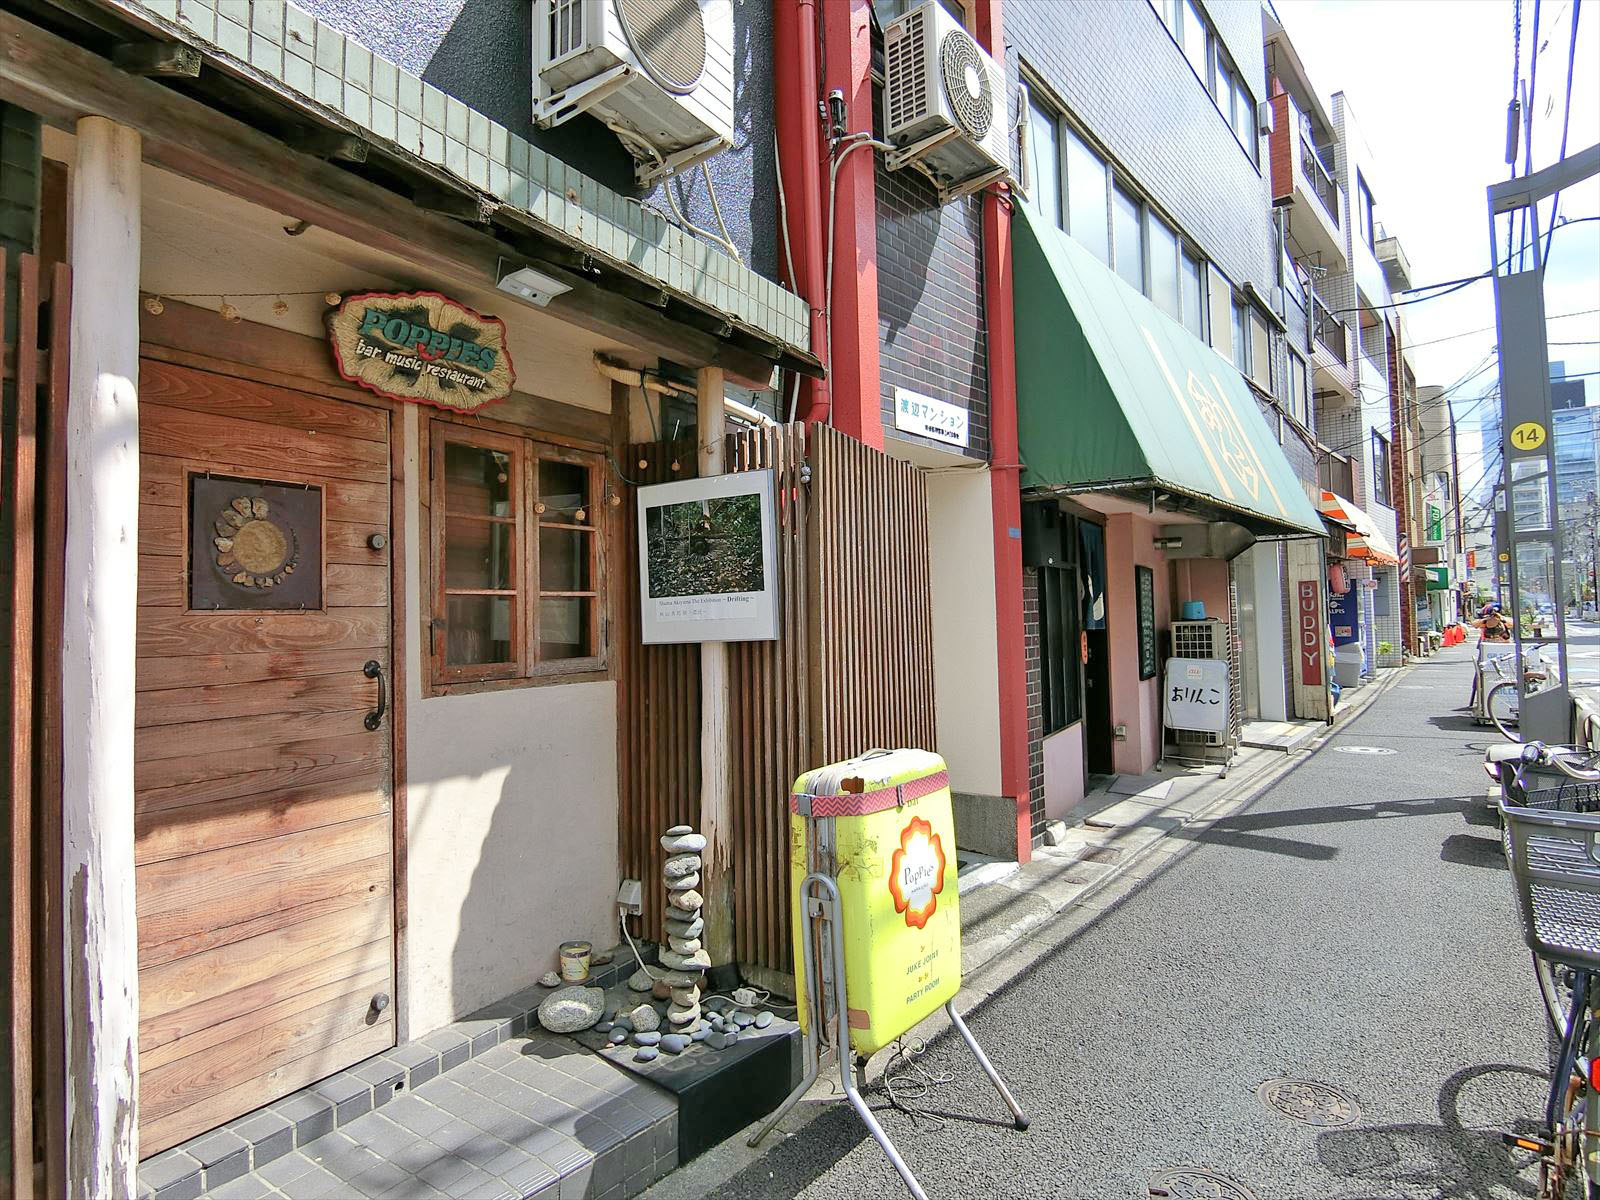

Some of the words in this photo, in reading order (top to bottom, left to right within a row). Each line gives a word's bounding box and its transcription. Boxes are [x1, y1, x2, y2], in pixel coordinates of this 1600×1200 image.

[358, 307, 497, 373] POPPIES
[356, 339, 382, 359] bar
[384, 351, 422, 371] music
[425, 362, 486, 390] restaurant
[1515, 428, 1540, 444] 14
[1301, 584, 1318, 666] BUDDY
[906, 959, 921, 975] JUKE
[906, 987, 923, 1005] PARTY
[924, 977, 940, 993] ROOM
